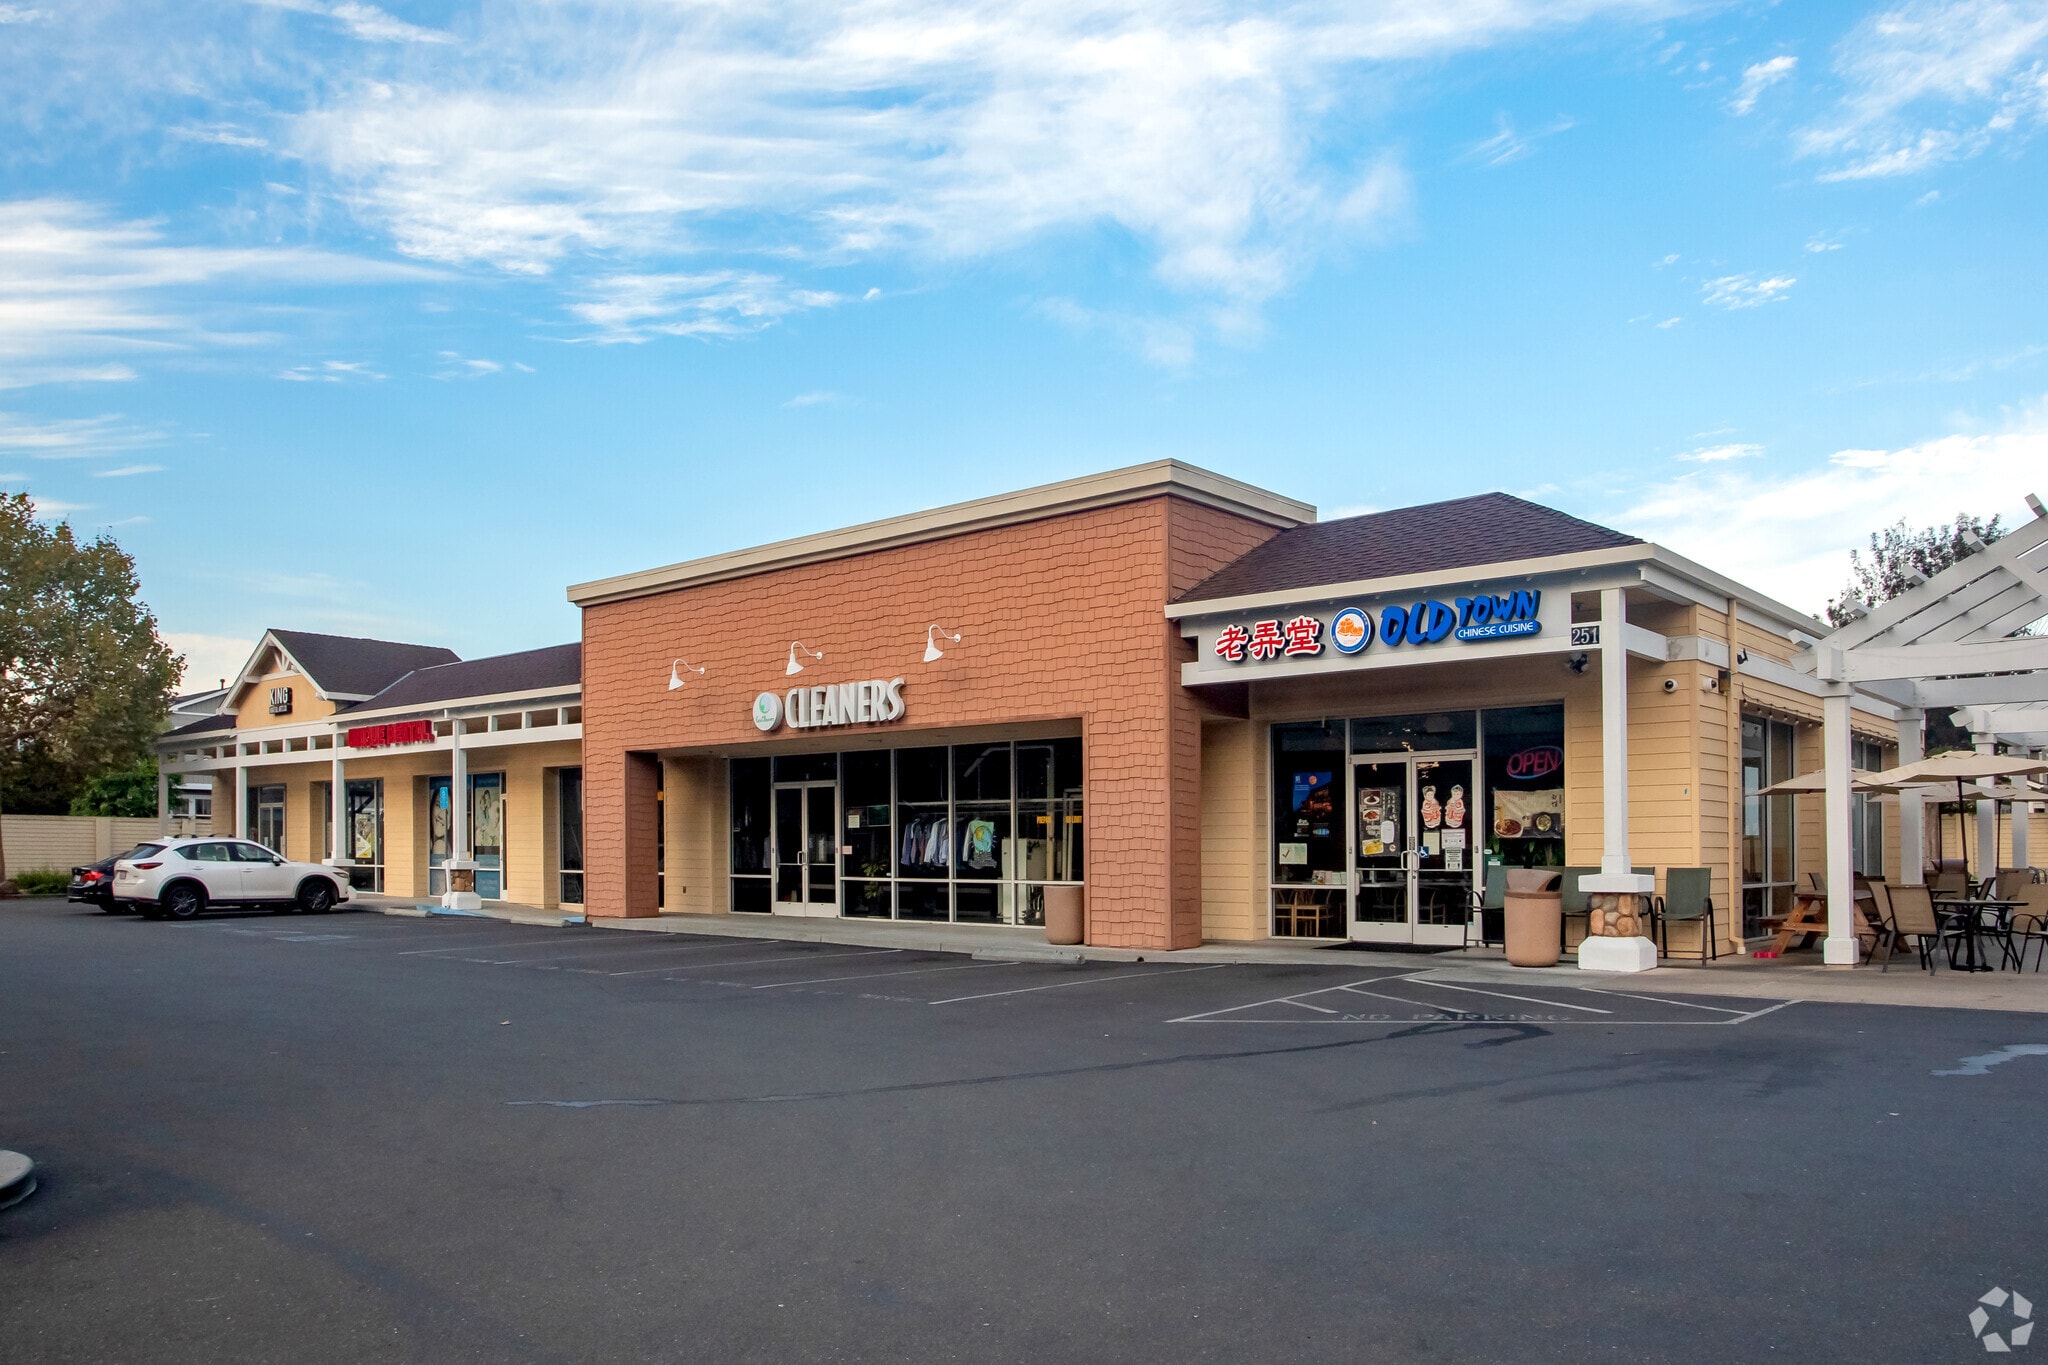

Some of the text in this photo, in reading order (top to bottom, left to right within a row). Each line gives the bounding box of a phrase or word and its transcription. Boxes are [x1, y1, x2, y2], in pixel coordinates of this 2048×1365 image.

[1380, 589, 1540, 646] OLD TOWN
[1215, 615, 1322, 661] 老弄堂
[1458, 621, 1534, 638] CHINESE CUISINE
[1572, 627, 1599, 645] 251
[270, 687, 289, 705] KING
[785, 677, 905, 728] CLEANERS
[1507, 751, 1559, 774] OPEN
[1342, 1013, 1571, 1021] NO PARKING
